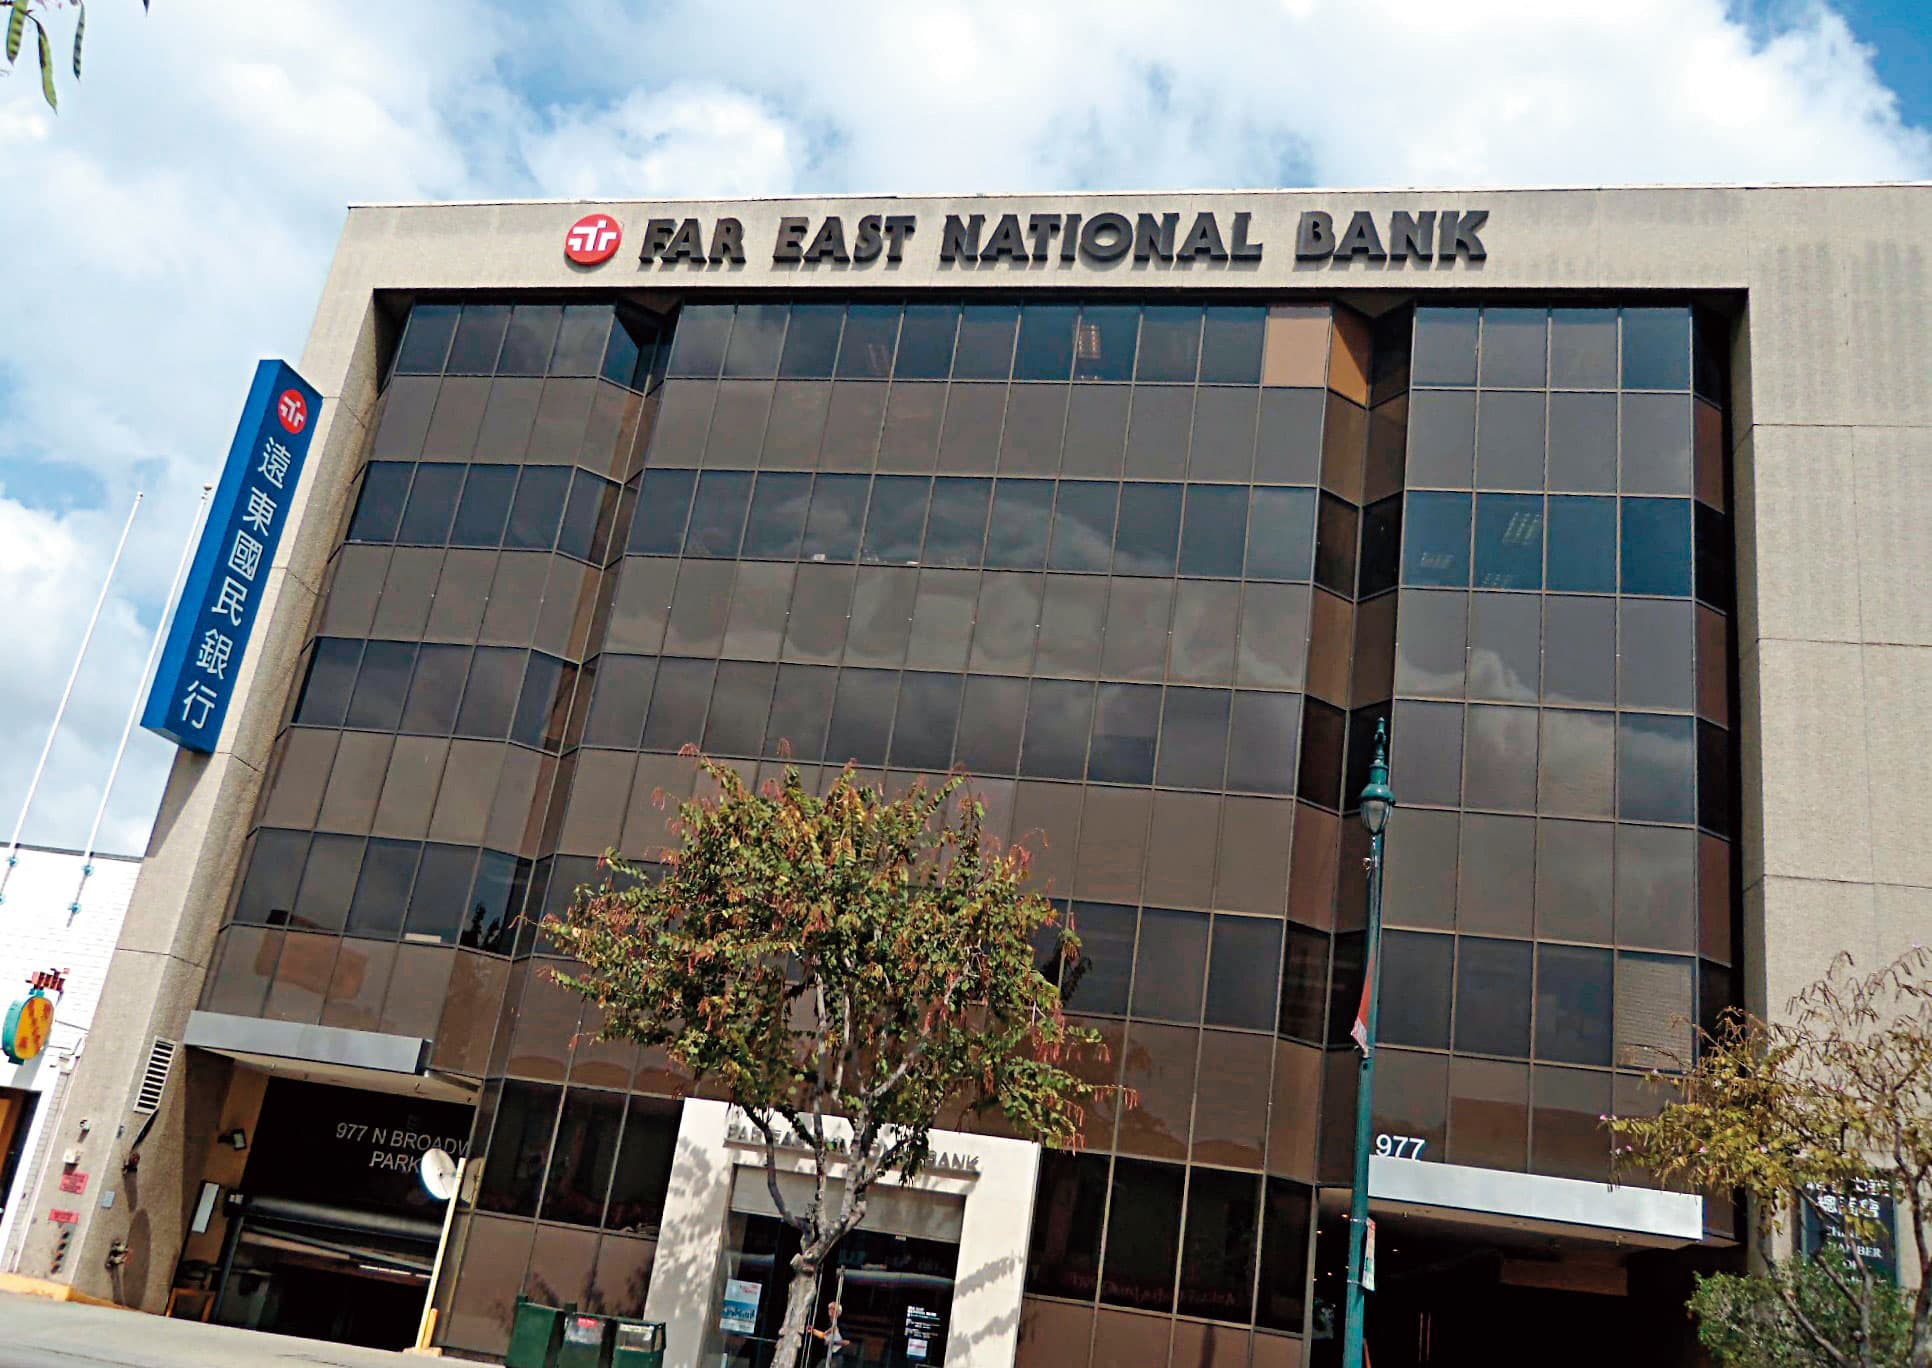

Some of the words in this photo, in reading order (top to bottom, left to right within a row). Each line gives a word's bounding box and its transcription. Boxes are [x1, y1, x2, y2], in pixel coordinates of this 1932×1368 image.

[638, 216, 747, 264] FAR
[772, 214, 916, 263] EAST
[939, 211, 1263, 264] NATIONAL
[1295, 209, 1490, 262] BANK
[183, 436, 292, 729] 遠東國民銀行
[335, 1121, 369, 1142] 977
[372, 1127, 387, 1145] N
[1375, 1133, 1426, 1161] 977
